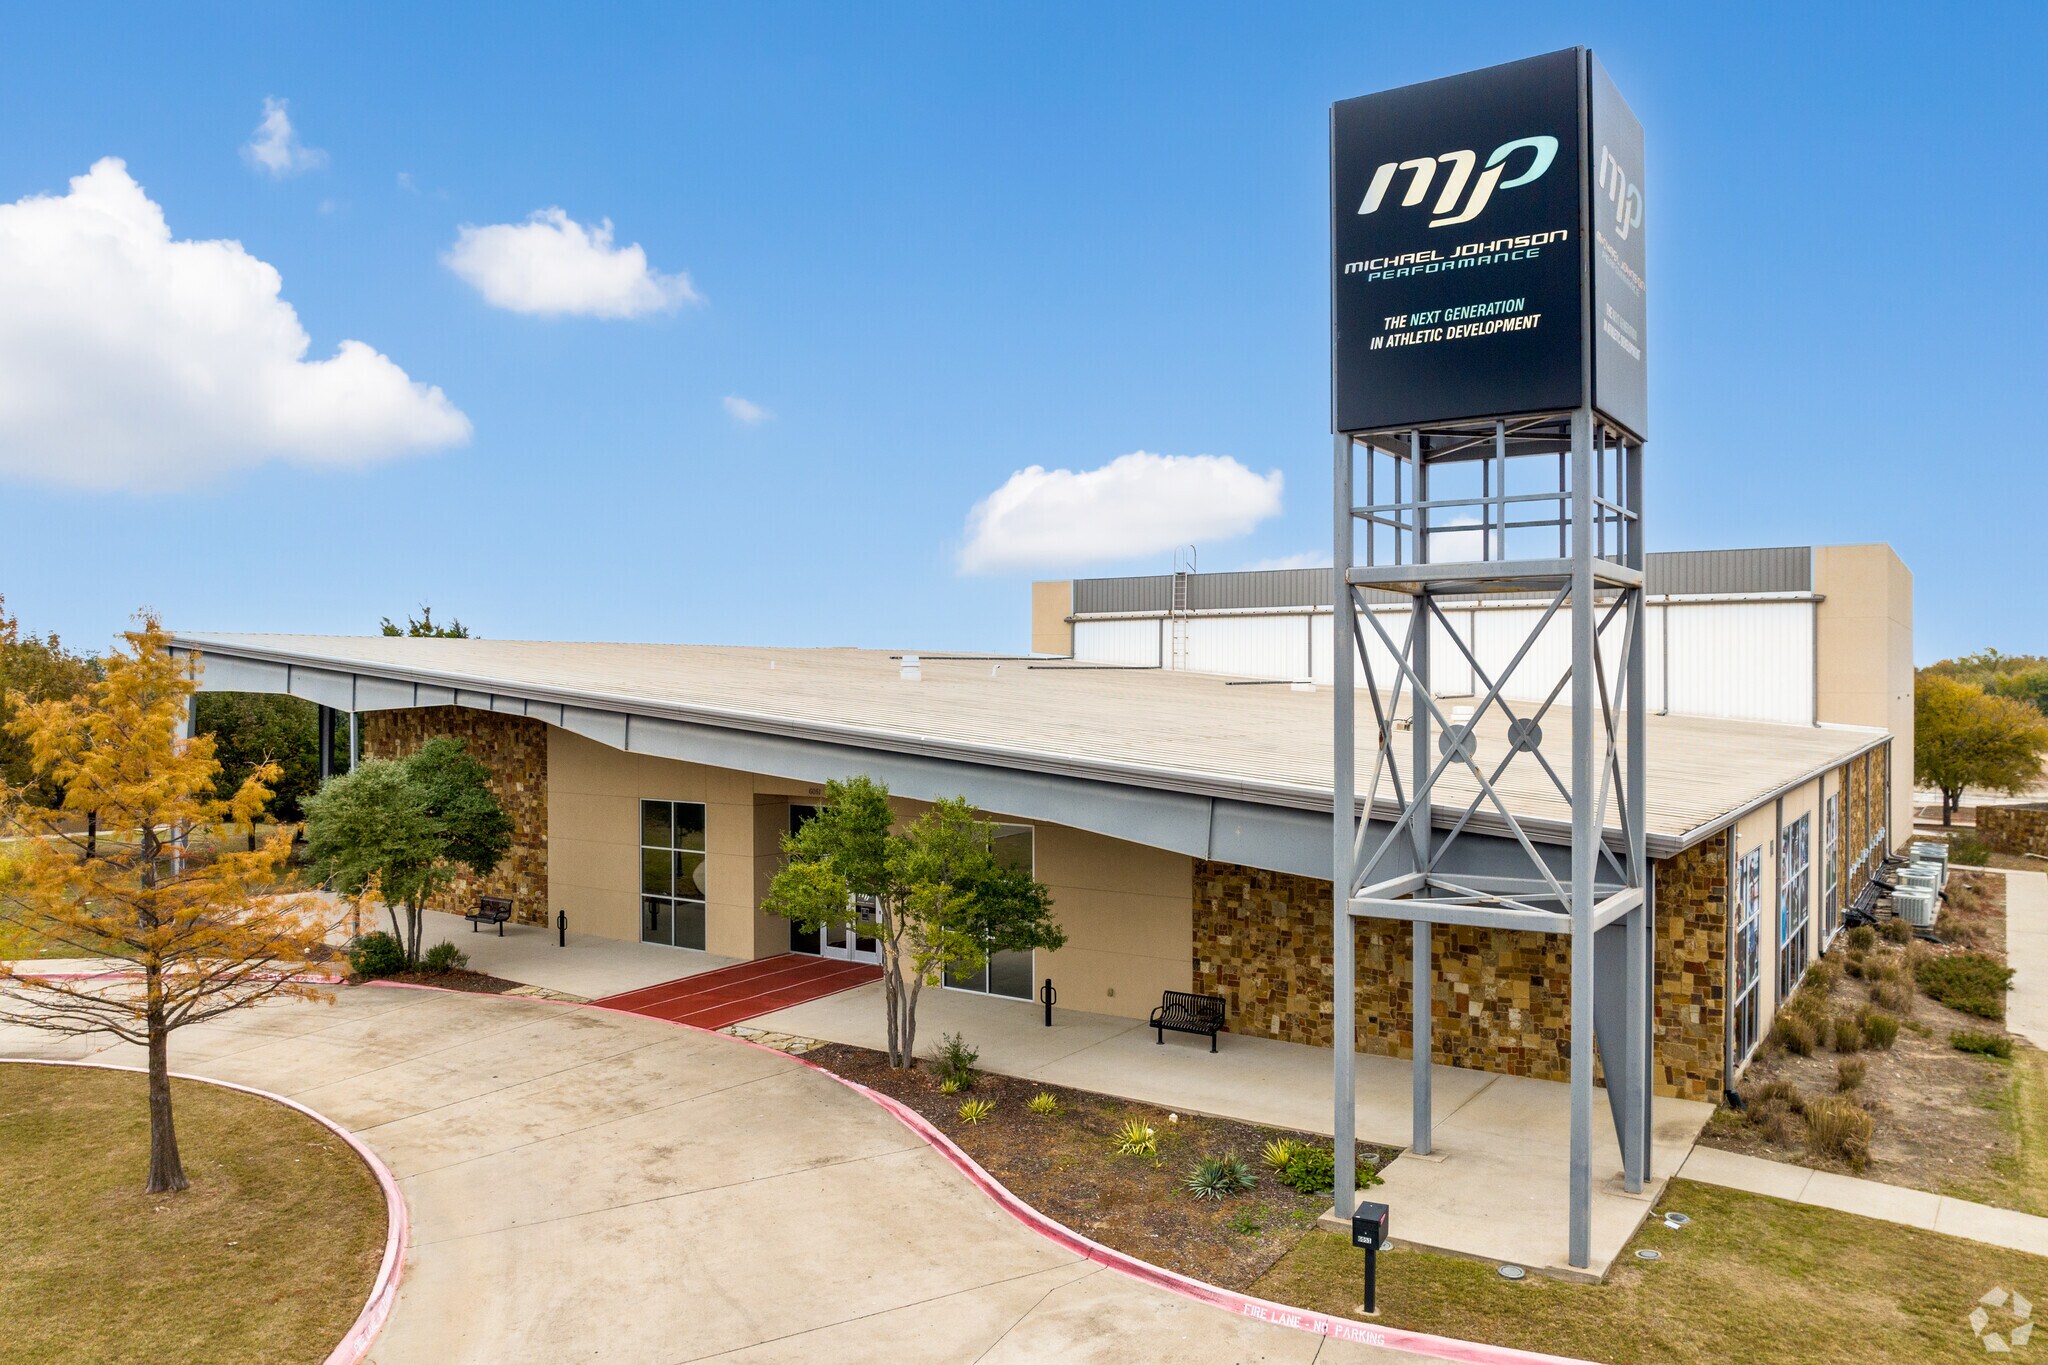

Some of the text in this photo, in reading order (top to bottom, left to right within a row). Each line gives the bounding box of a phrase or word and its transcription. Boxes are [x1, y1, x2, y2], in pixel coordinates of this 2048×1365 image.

[1345, 229, 1568, 275] MICHAEL JOHNSON
[1368, 247, 1540, 283] PERFORMANCE
[1370, 314, 1541, 350] IN ATHLETIC DEVELOPMENT
[1384, 298, 1525, 330] THE NEXT GENERATION
[1243, 1303, 1268, 1320] FIRE
[1271, 1311, 1302, 1329] LANE
[1313, 1319, 1328, 1334] NO
[1334, 1324, 1385, 1345] PARKING
